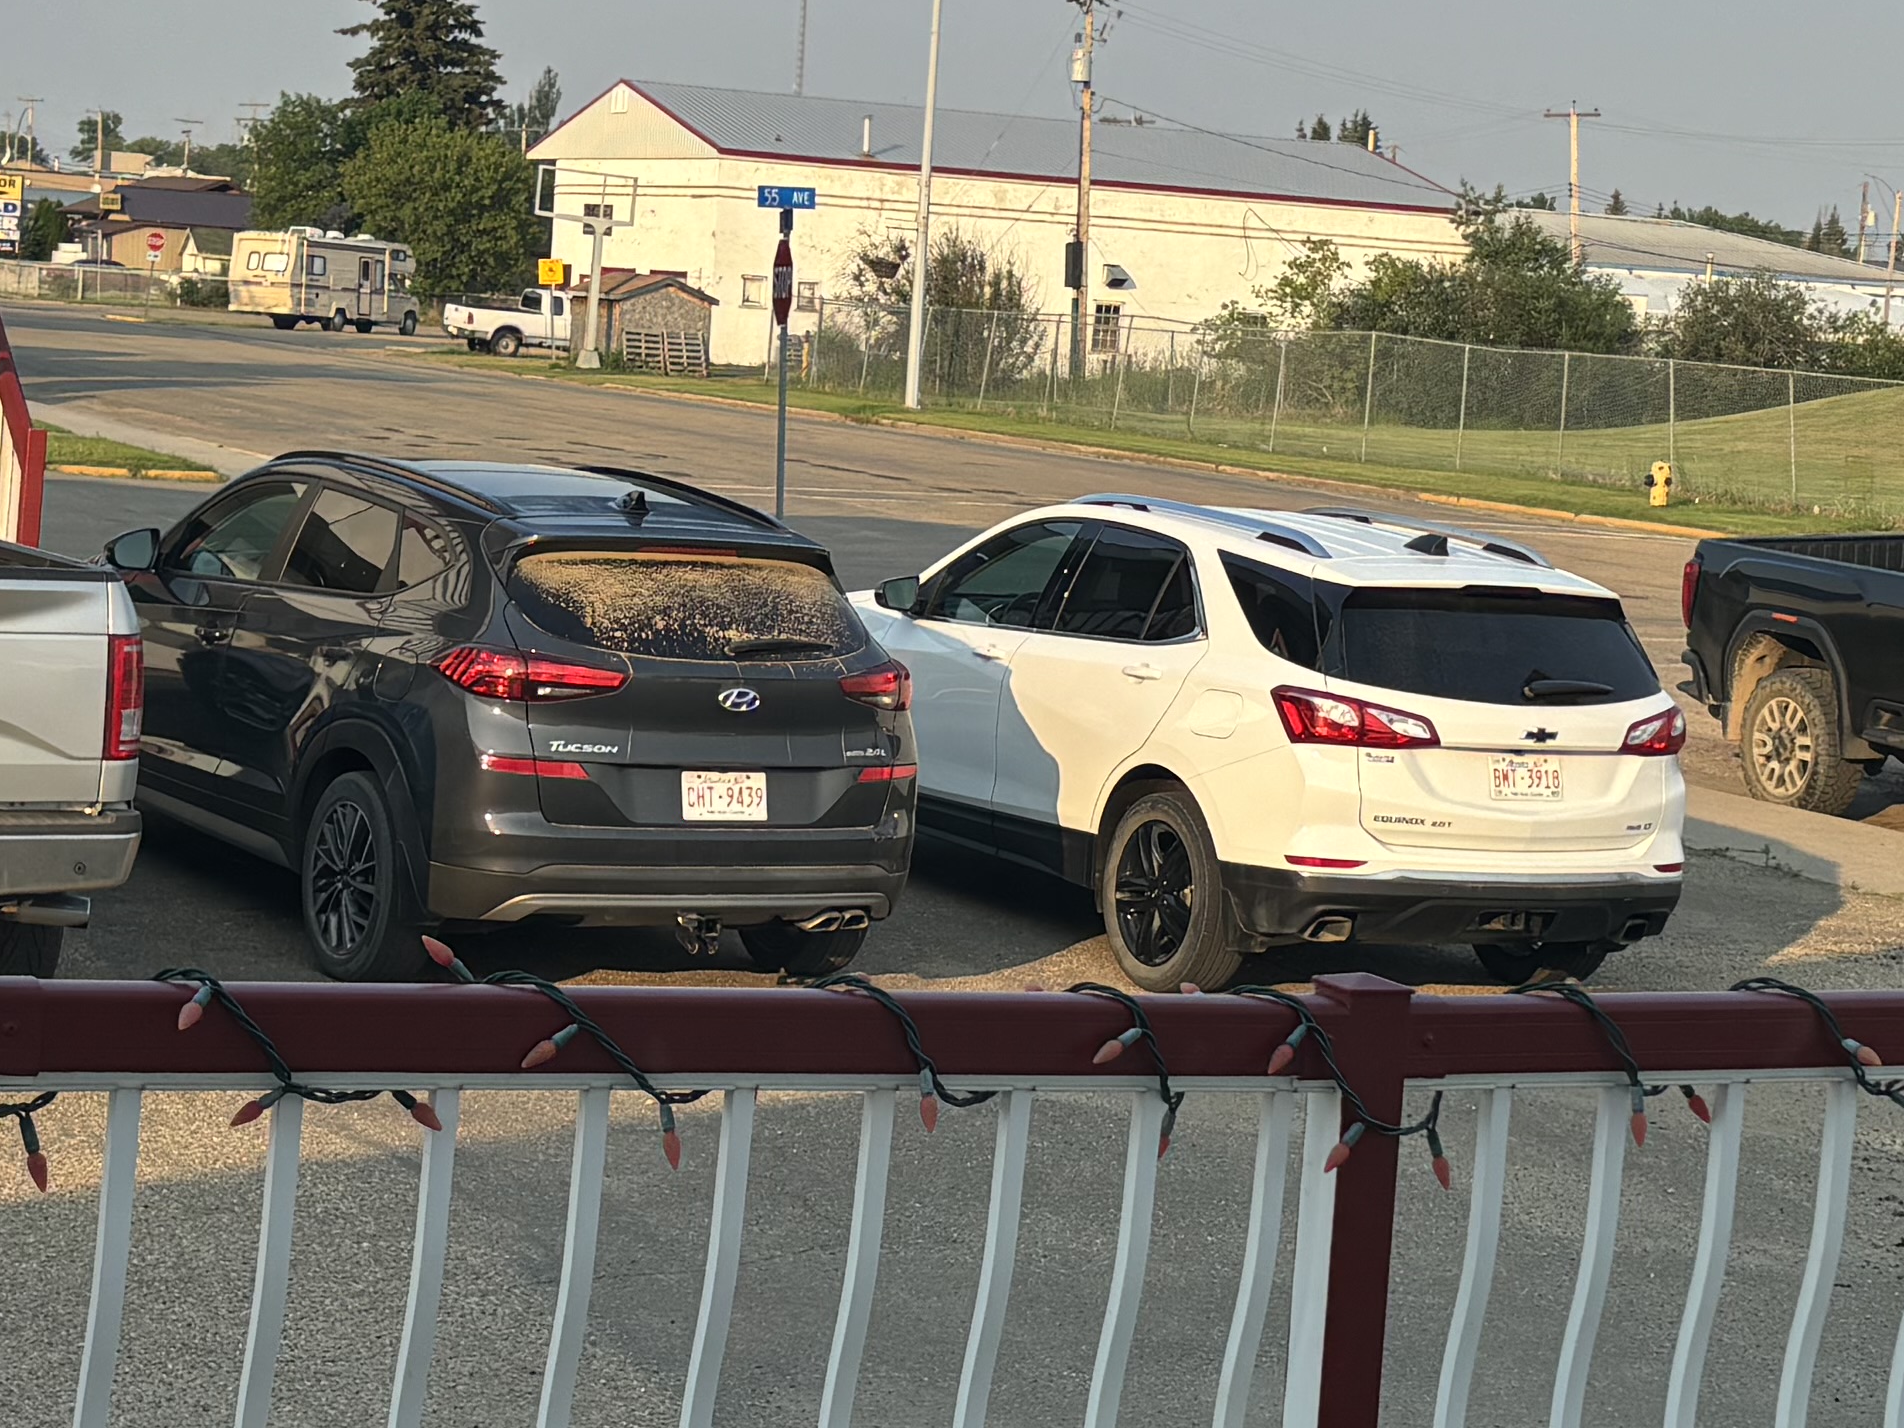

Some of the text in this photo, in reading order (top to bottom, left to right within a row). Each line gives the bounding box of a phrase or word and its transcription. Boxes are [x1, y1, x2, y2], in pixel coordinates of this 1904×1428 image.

[764, 188, 810, 206] 55 AVE
[549, 740, 619, 754] TUCSON
[1373, 814, 1426, 826] EQUINOX
